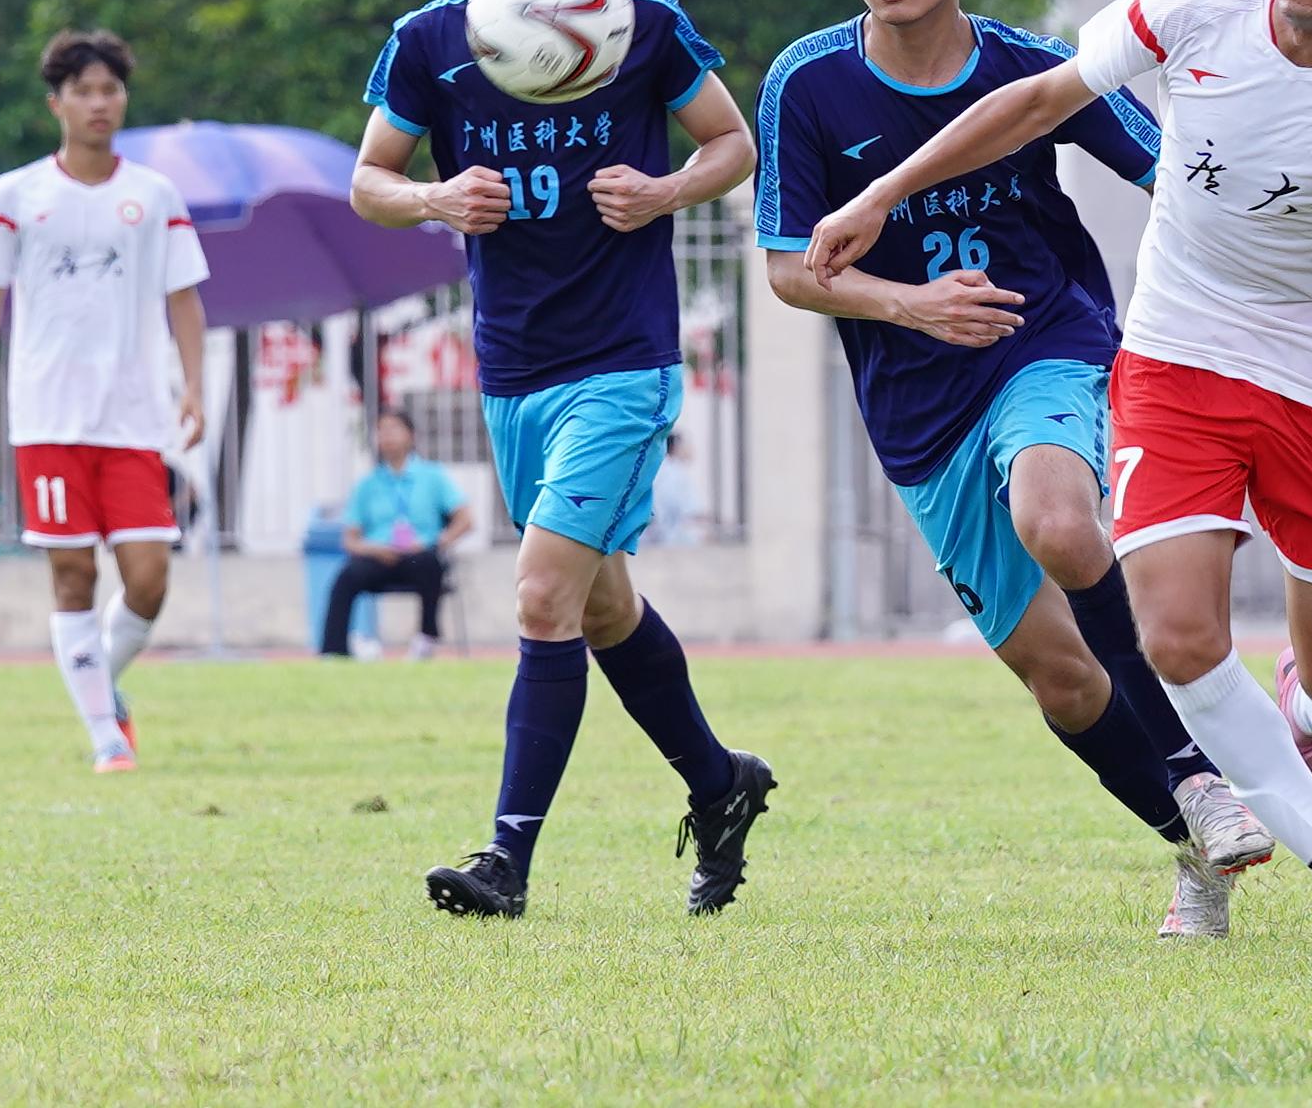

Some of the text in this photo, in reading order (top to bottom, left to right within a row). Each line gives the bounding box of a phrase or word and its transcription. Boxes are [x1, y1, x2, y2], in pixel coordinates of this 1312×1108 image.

[463, 111, 613, 157] 广州医科大学
[503, 164, 560, 220] 19
[890, 173, 1022, 225] 州医科大学
[922, 225, 990, 283] 26
[34, 475, 68, 524] 11
[1113, 445, 1144, 521] 7
